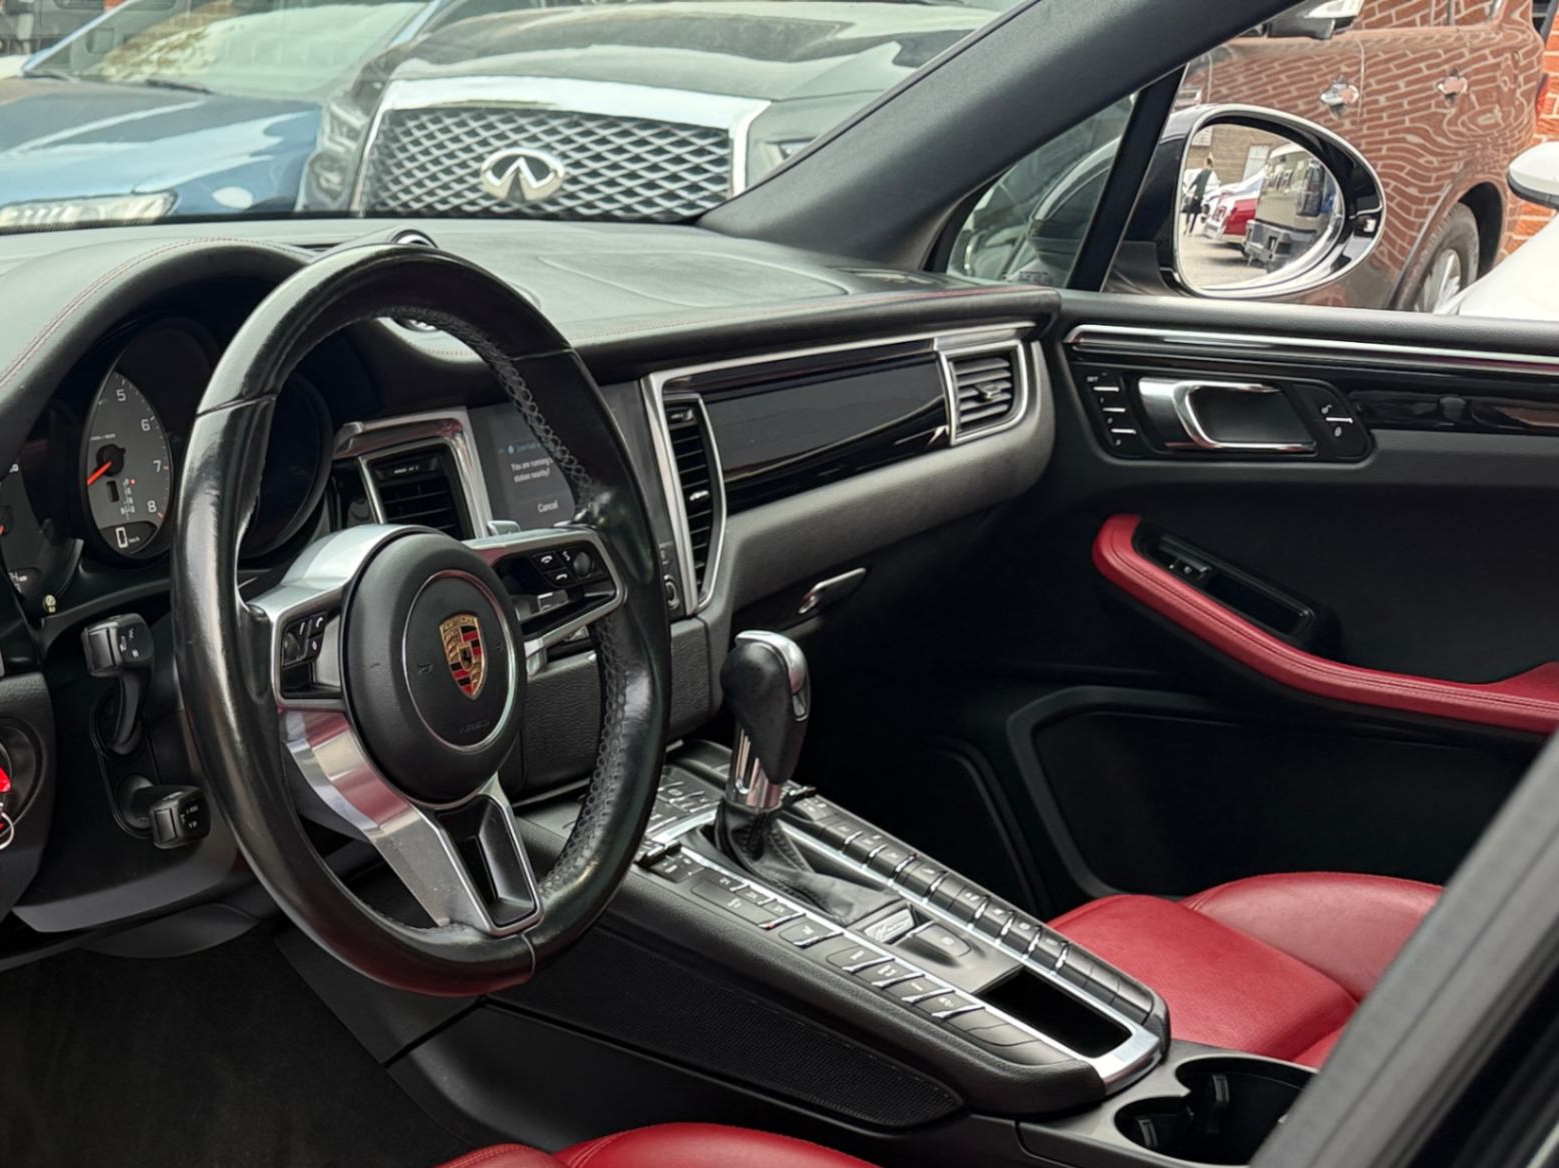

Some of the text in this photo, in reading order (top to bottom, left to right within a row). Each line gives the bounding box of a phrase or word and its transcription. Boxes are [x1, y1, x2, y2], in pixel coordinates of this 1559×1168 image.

[116, 388, 127, 402] 5
[140, 418, 151, 432] 6
[153, 459, 163, 473] 7
[147, 499, 158, 513] 8
[115, 526, 129, 549] 0
